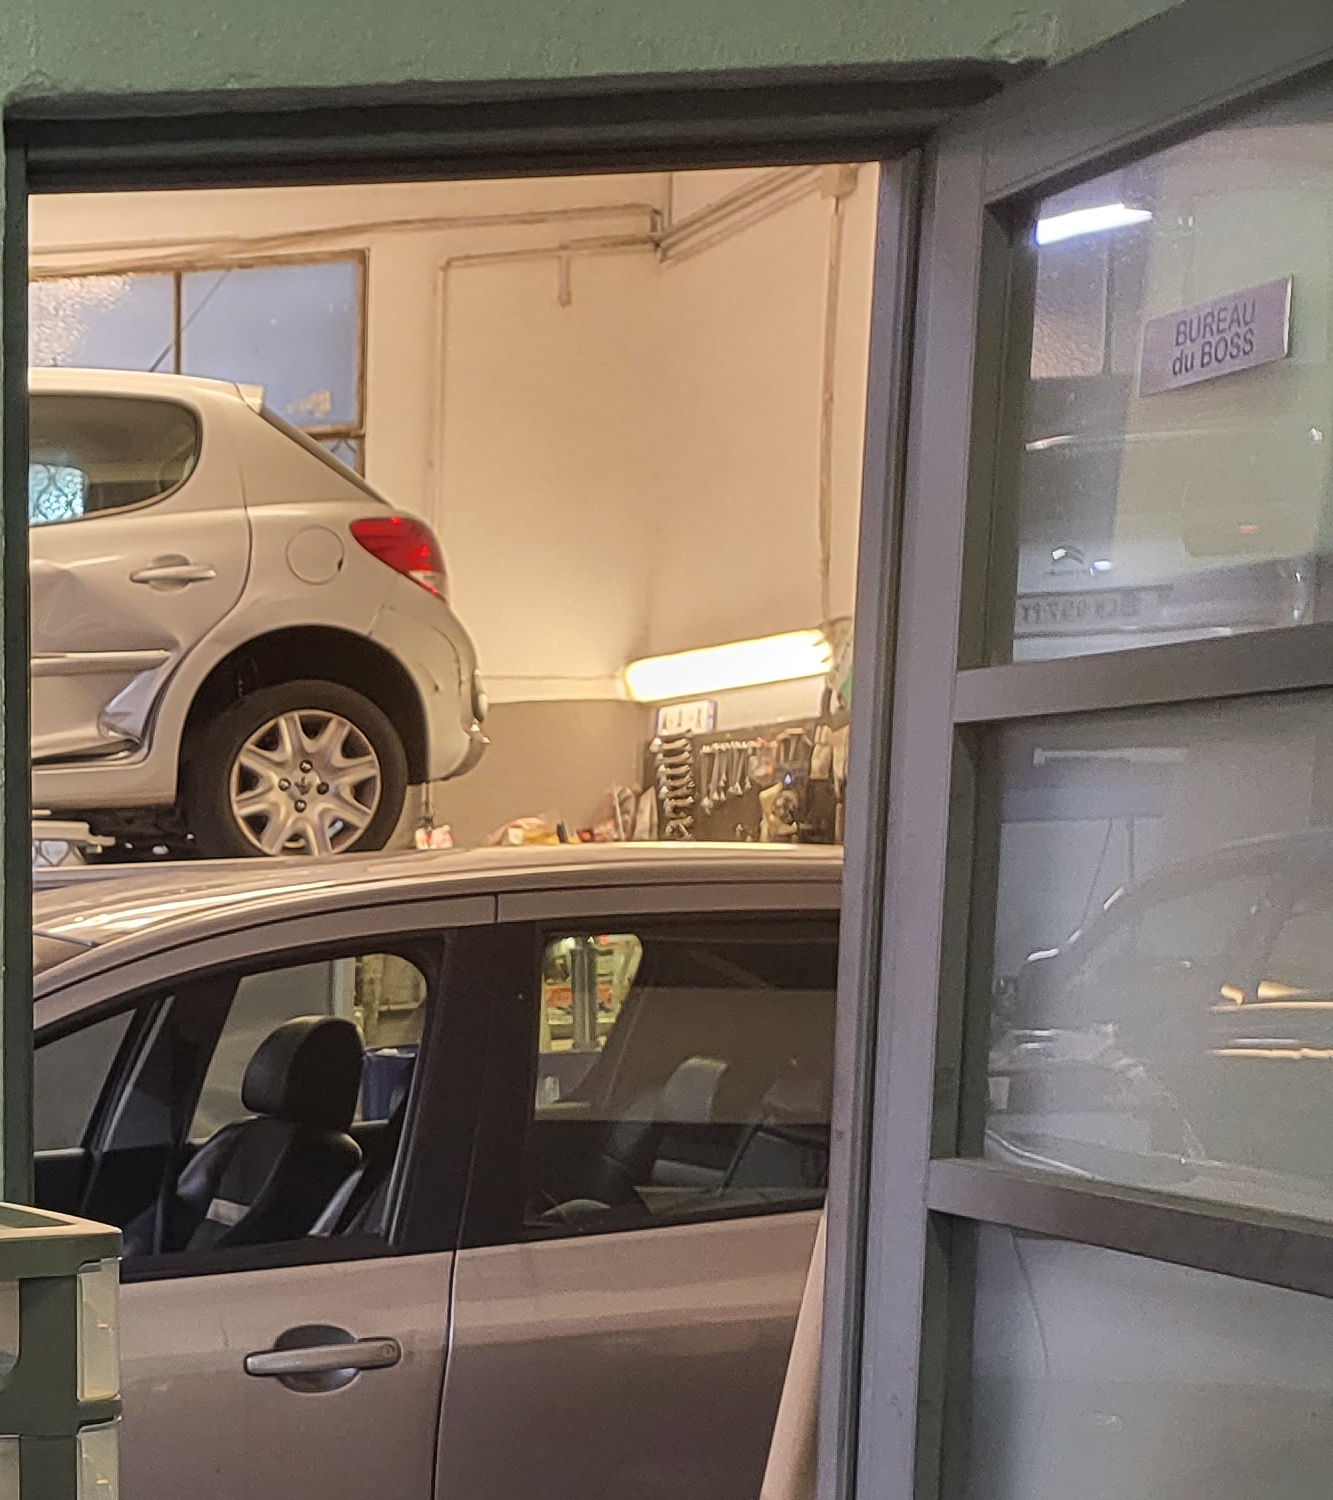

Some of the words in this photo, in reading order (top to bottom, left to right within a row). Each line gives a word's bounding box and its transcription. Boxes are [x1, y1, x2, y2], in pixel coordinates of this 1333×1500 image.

[1175, 299, 1255, 347] BUREAU
[1173, 348, 1195, 376] du
[1200, 328, 1254, 369] BOSS
